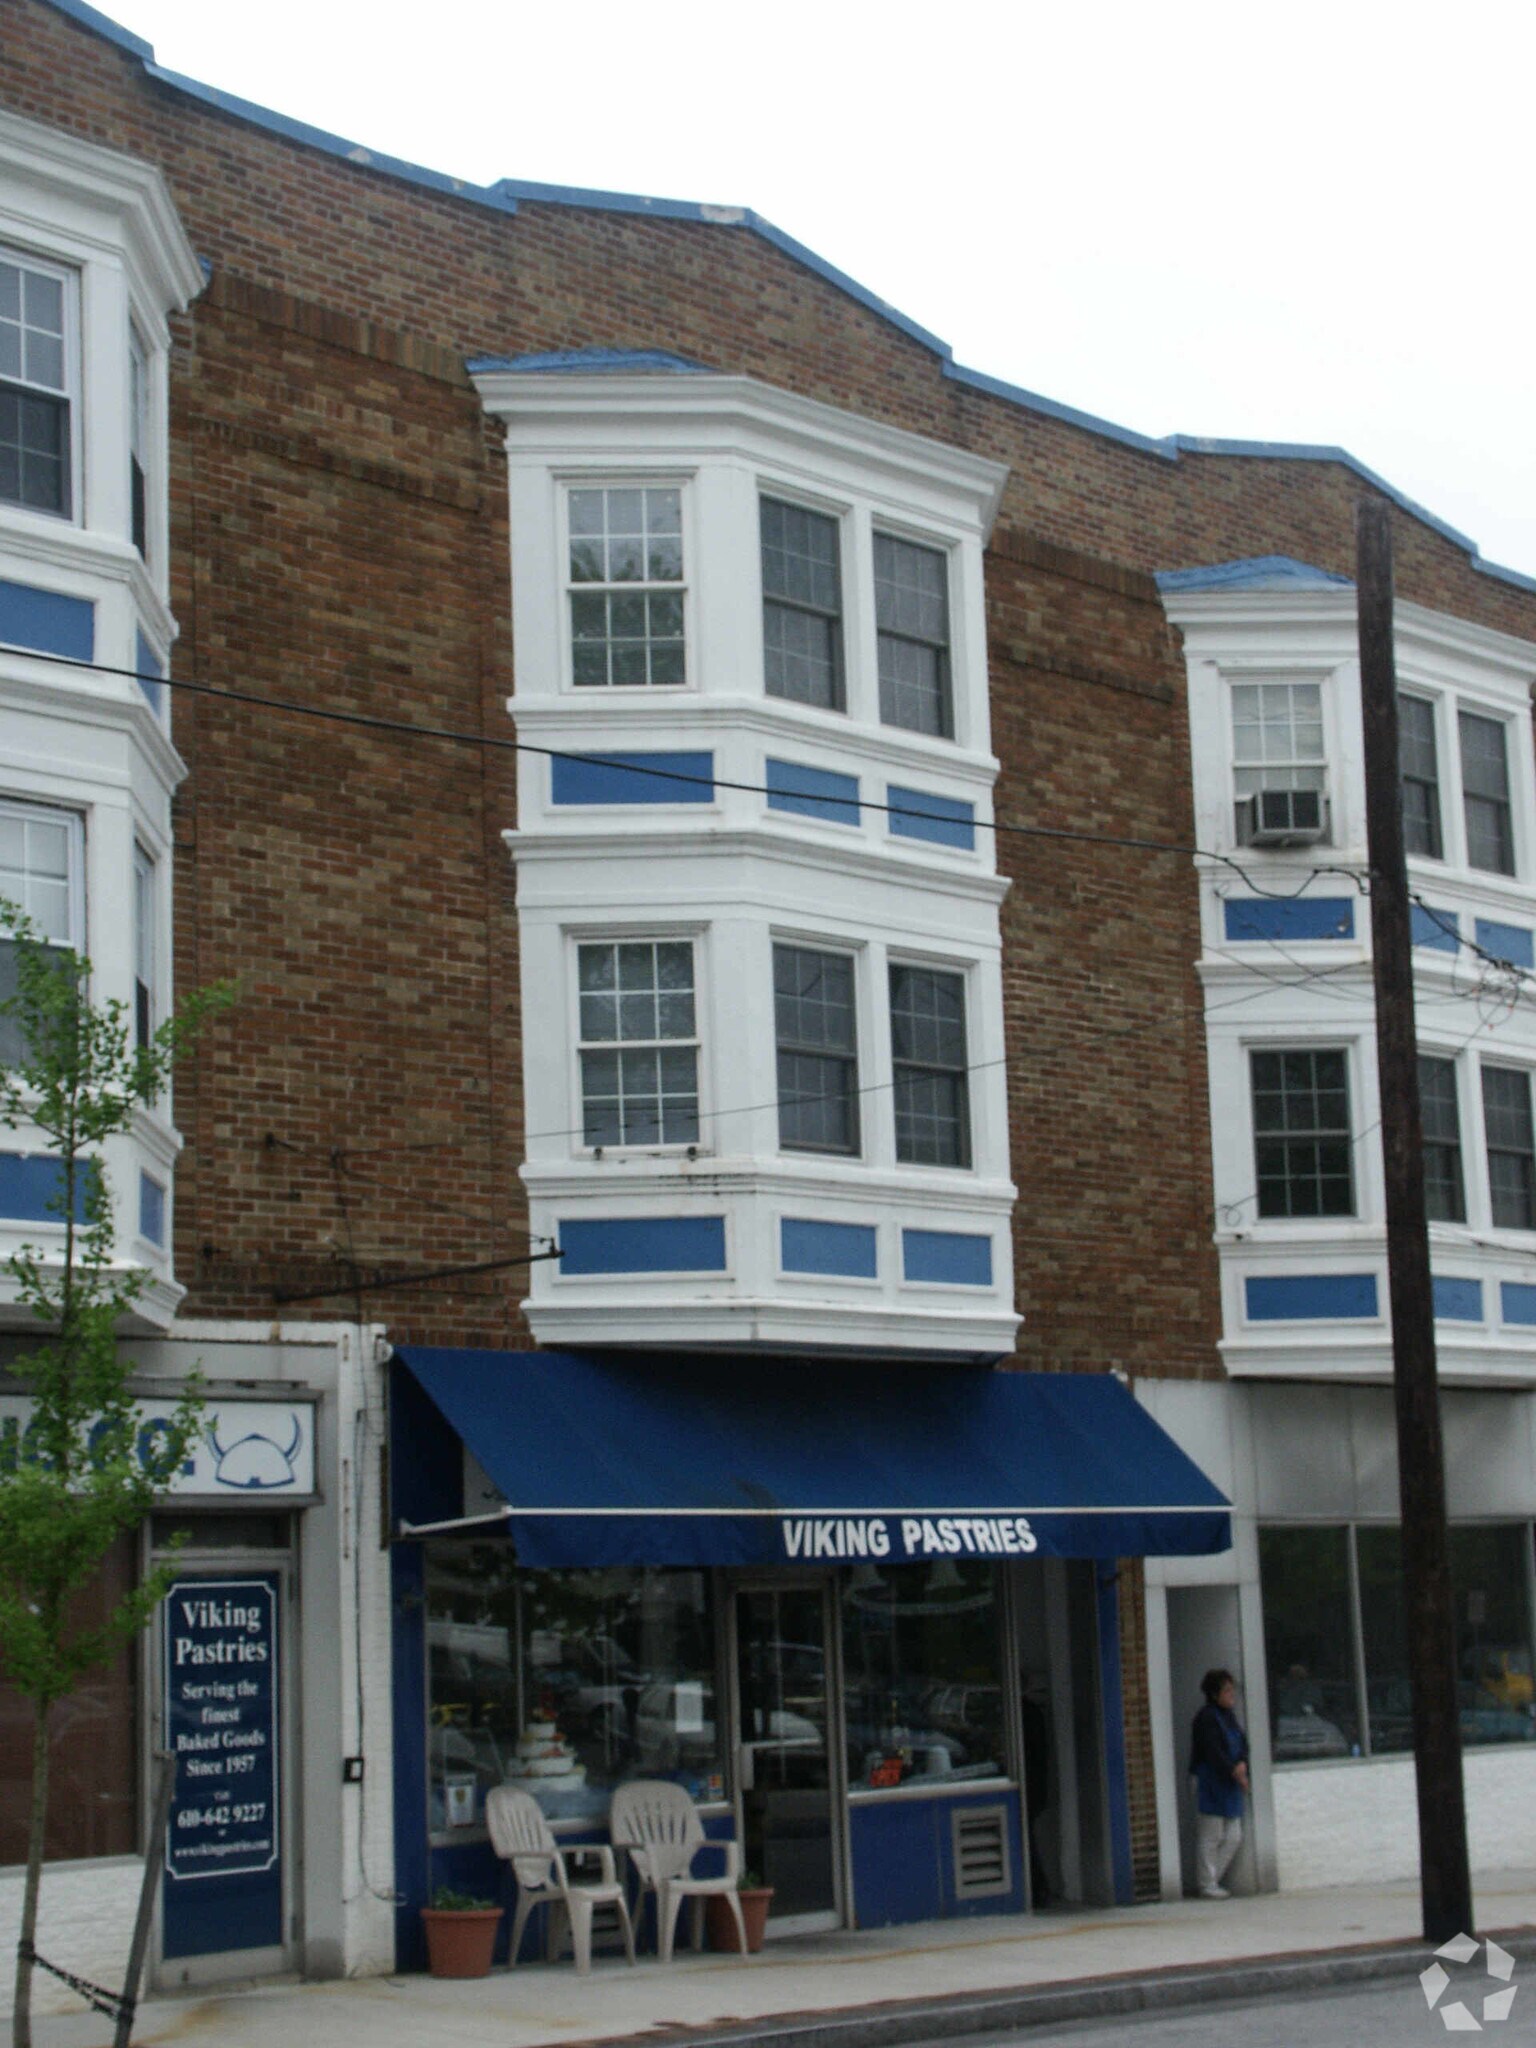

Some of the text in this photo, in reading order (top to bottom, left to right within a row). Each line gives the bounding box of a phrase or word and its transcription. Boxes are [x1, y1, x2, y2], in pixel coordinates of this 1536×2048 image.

[782, 1518, 1038, 1557] VIKING PASTRIES
[182, 1601, 261, 1633] Viking
[176, 1636, 267, 1665] Pastries
[182, 1679, 258, 1701] Serving the
[177, 1729, 265, 1750] Baked Goods
[186, 1754, 256, 1777] Since 1957
